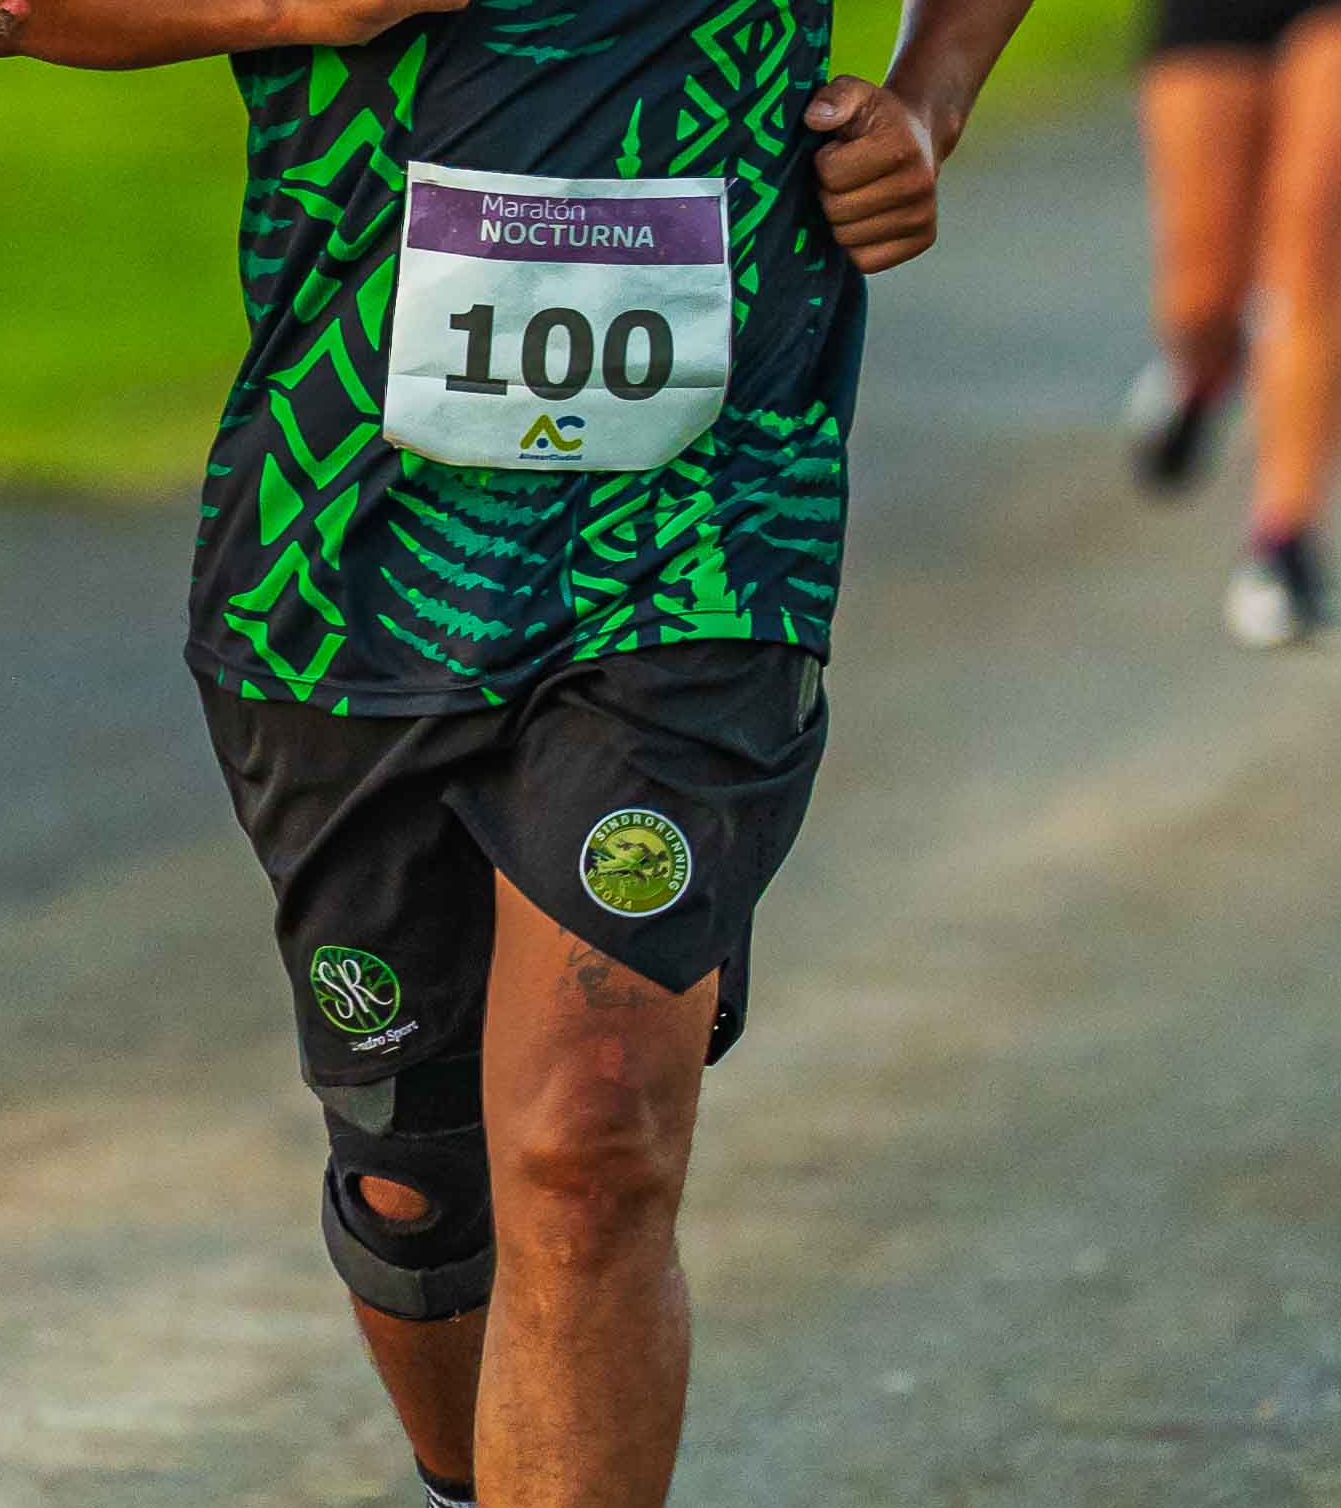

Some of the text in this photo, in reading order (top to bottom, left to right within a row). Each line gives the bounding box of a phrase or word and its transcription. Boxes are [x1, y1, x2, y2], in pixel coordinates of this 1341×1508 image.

[480, 219, 655, 249] NOCTURNA
[482, 194, 586, 221] Maratón
[445, 304, 674, 401] 100
[594, 813, 687, 891] SINDRORUNNING
[318, 959, 394, 1019] SR
